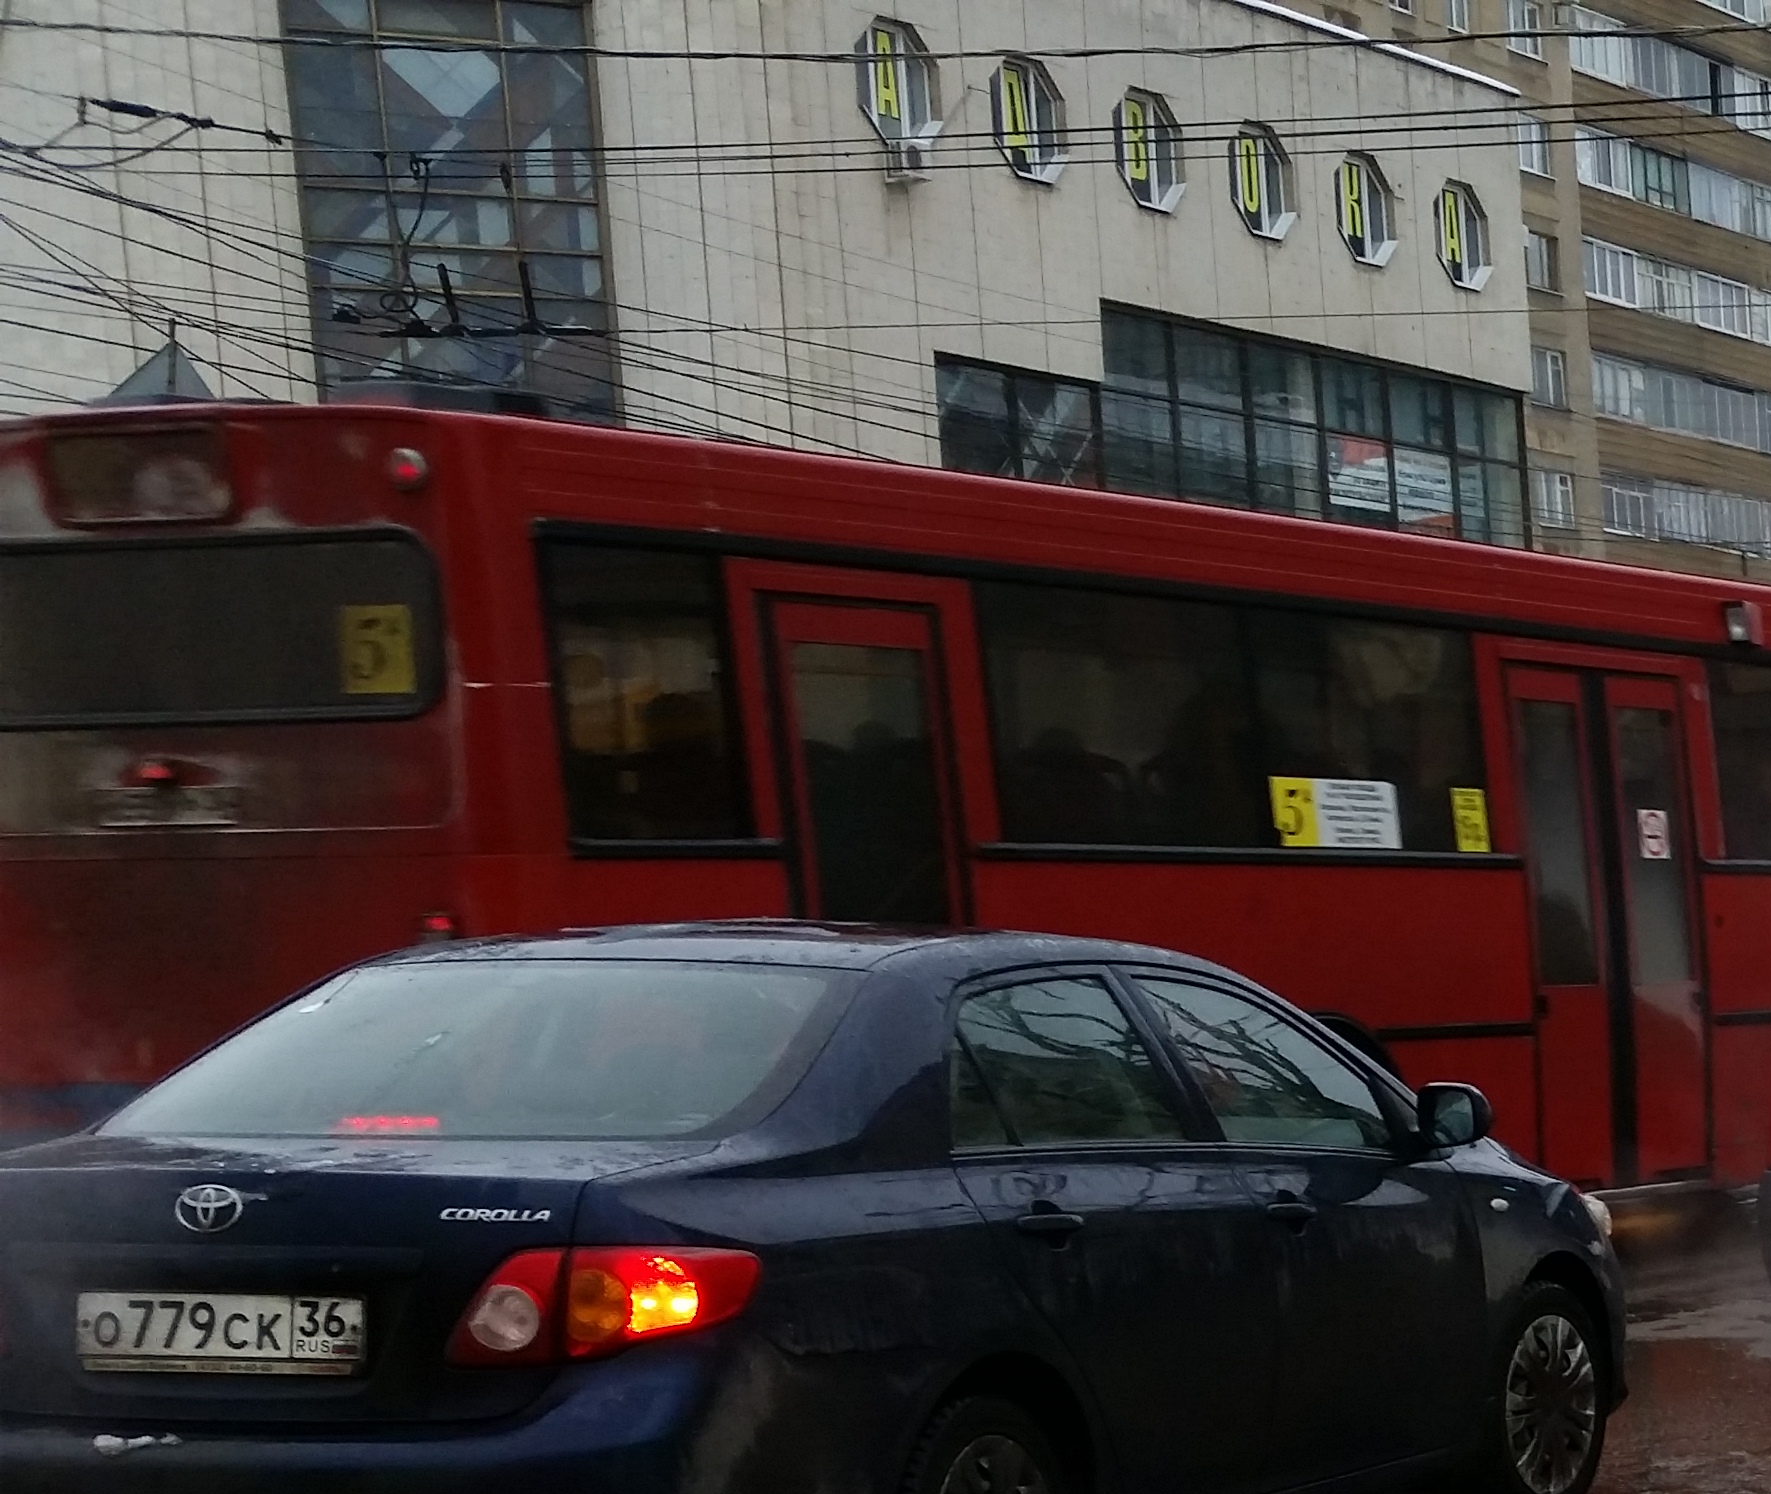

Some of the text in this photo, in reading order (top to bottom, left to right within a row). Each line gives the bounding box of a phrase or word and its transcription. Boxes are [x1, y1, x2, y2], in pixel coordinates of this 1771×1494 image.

[440, 1208, 551, 1222] COROLLA
[299, 1301, 346, 1338] 36
[295, 1340, 330, 1353] RUS
